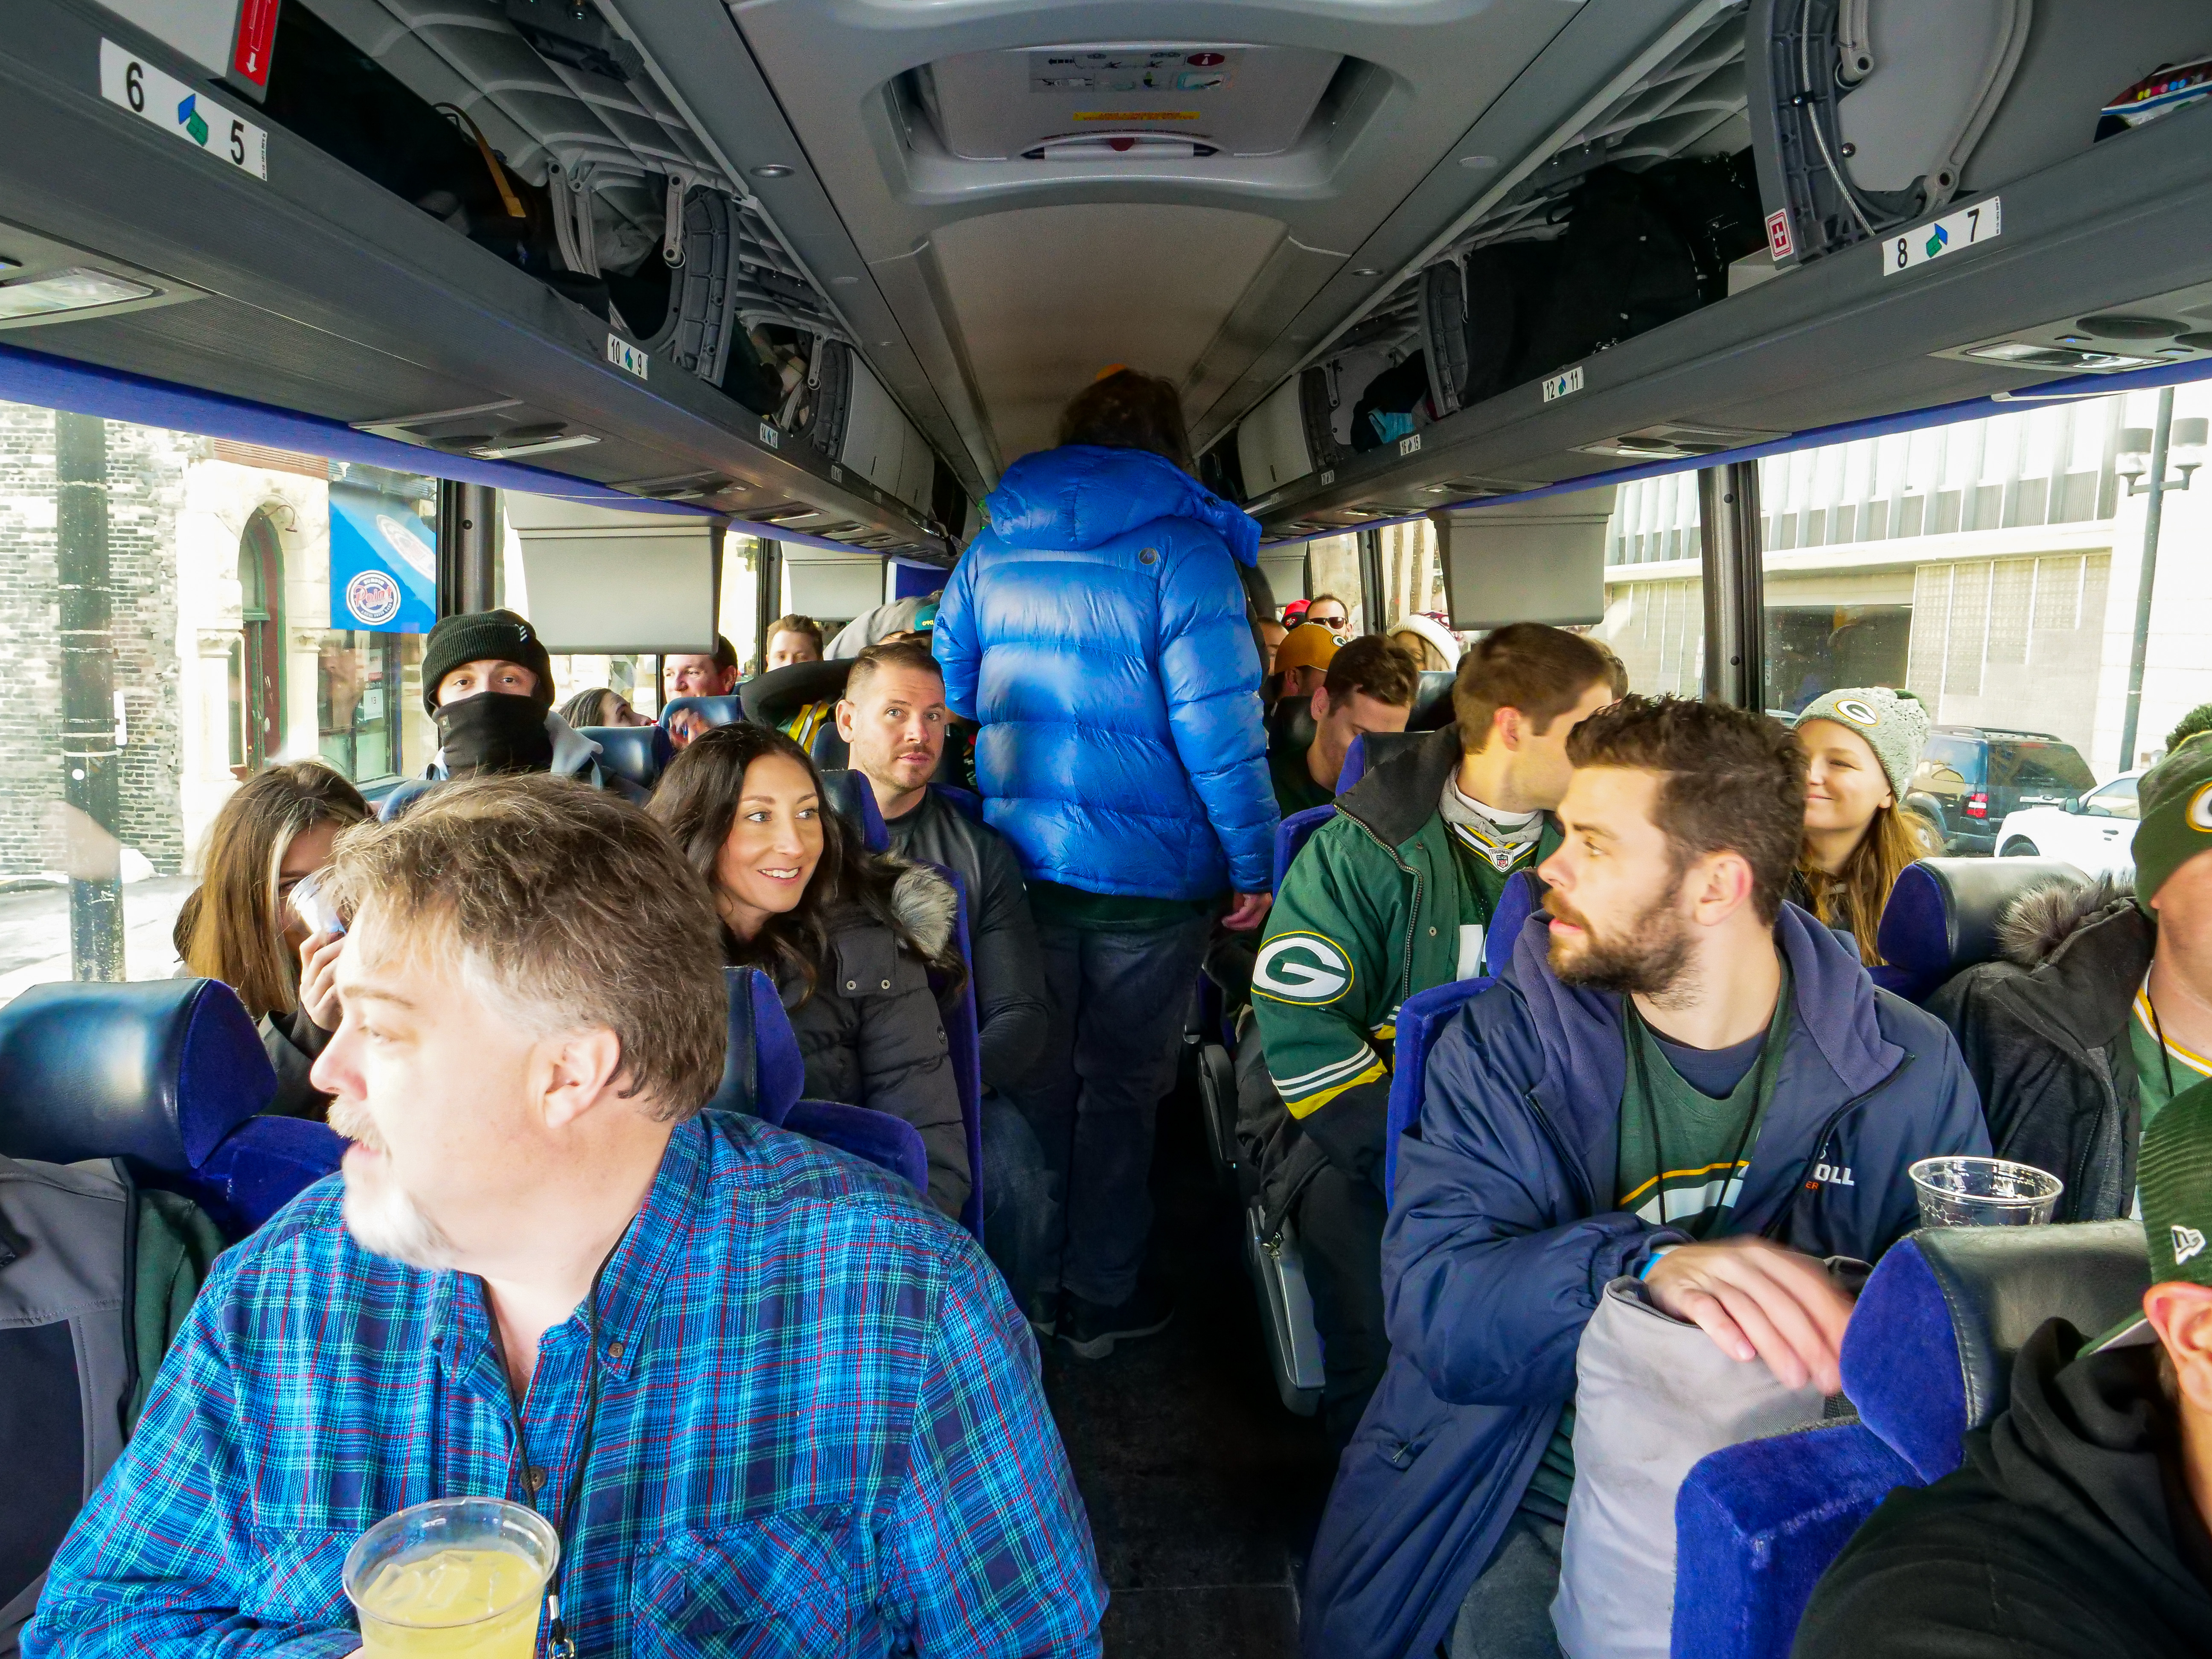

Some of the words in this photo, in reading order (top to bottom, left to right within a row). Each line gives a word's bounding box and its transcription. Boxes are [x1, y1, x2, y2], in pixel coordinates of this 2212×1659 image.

[126, 61, 145, 113] 6
[230, 119, 245, 166] 5
[1897, 238, 1908, 268] 8
[1967, 207, 1980, 242] 7
[611, 338, 620, 364] 10
[637, 353, 642, 375] 9
[1546, 380, 1555, 400] 12
[1571, 370, 1578, 390] 11
[761, 425, 766, 441] 14
[1401, 441, 1406, 454] 16
[1414, 436, 1419, 450] 15
[353, 585, 392, 607] Point
[1253, 937, 1346, 997] G
